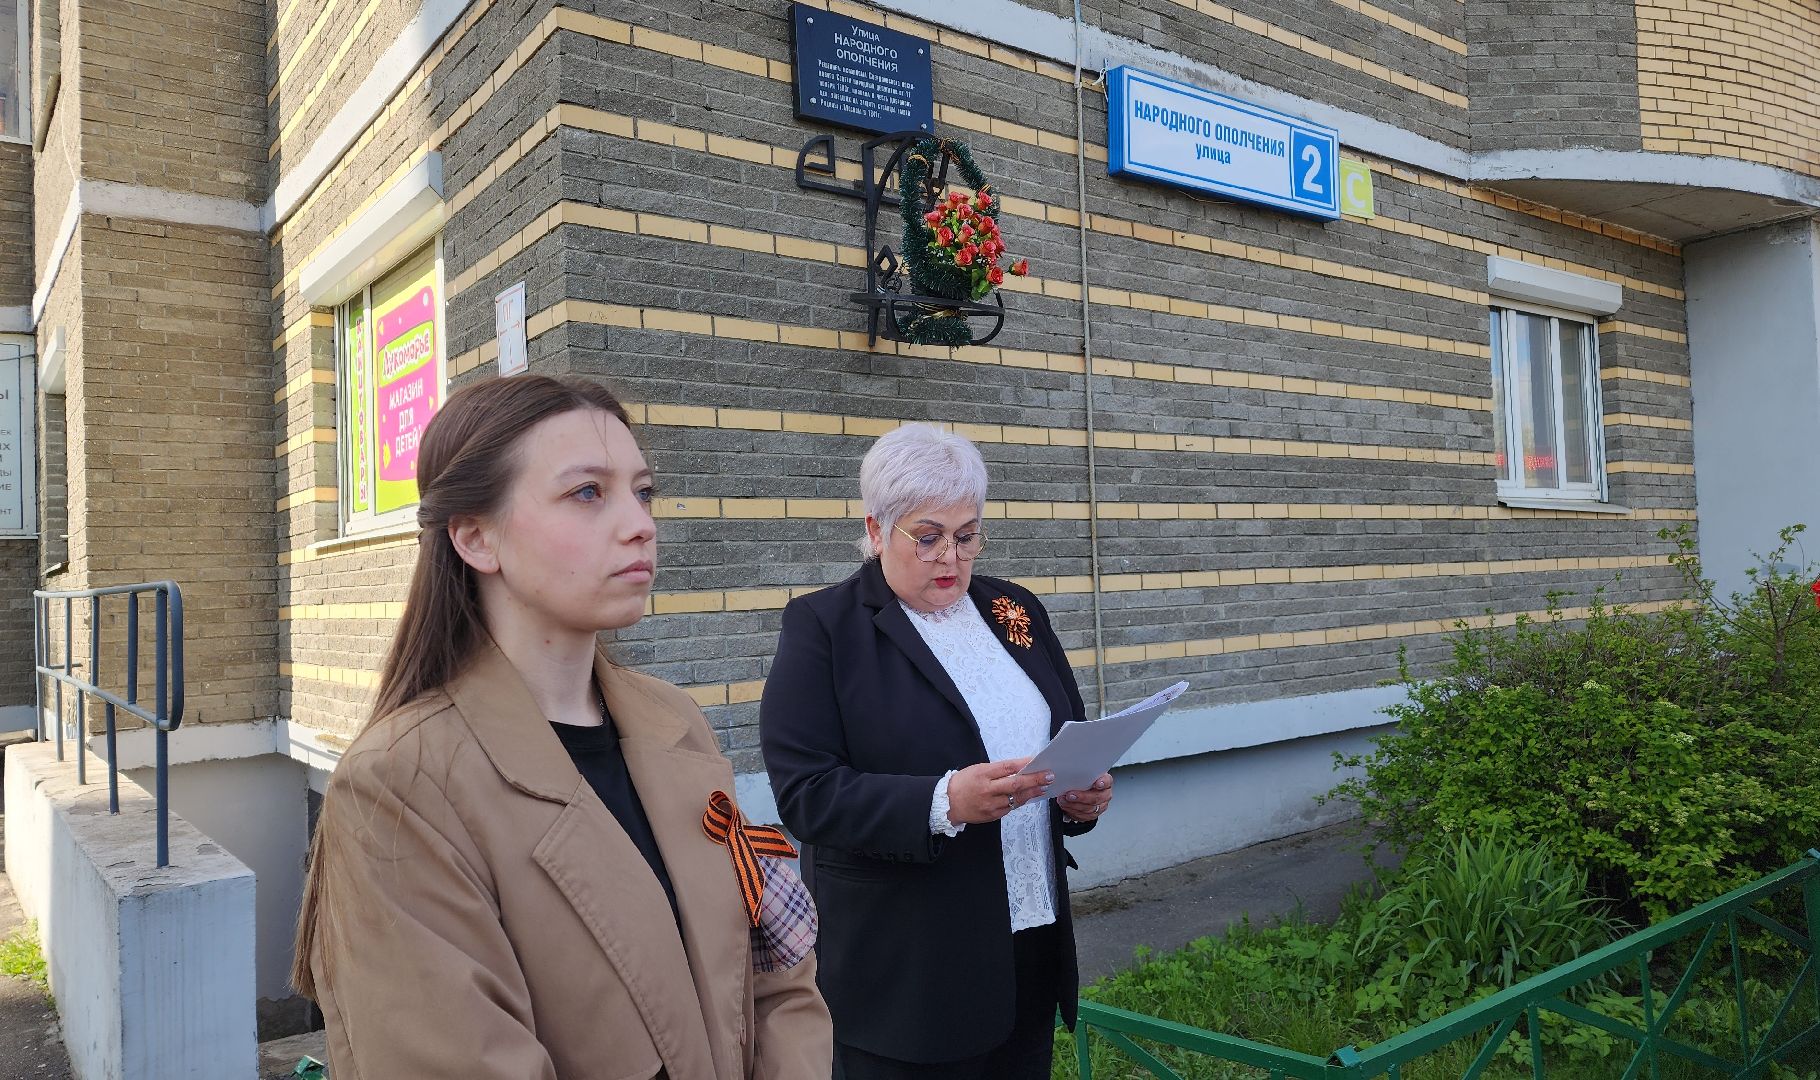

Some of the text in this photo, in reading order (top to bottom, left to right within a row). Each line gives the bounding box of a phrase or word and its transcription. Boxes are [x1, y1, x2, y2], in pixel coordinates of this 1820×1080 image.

[834, 32, 898, 59] НАРОДНОГО
[836, 48, 898, 72] ОПОЛЧЕНИЯ
[1134, 100, 1286, 158] НАРОДНОГО ОПОЛЧЕНИЯ
[1196, 142, 1232, 164] улица
[1301, 144, 1323, 194] 2
[389, 378, 424, 410] МАГАЗИН
[399, 407, 414, 432] ДЛЯ
